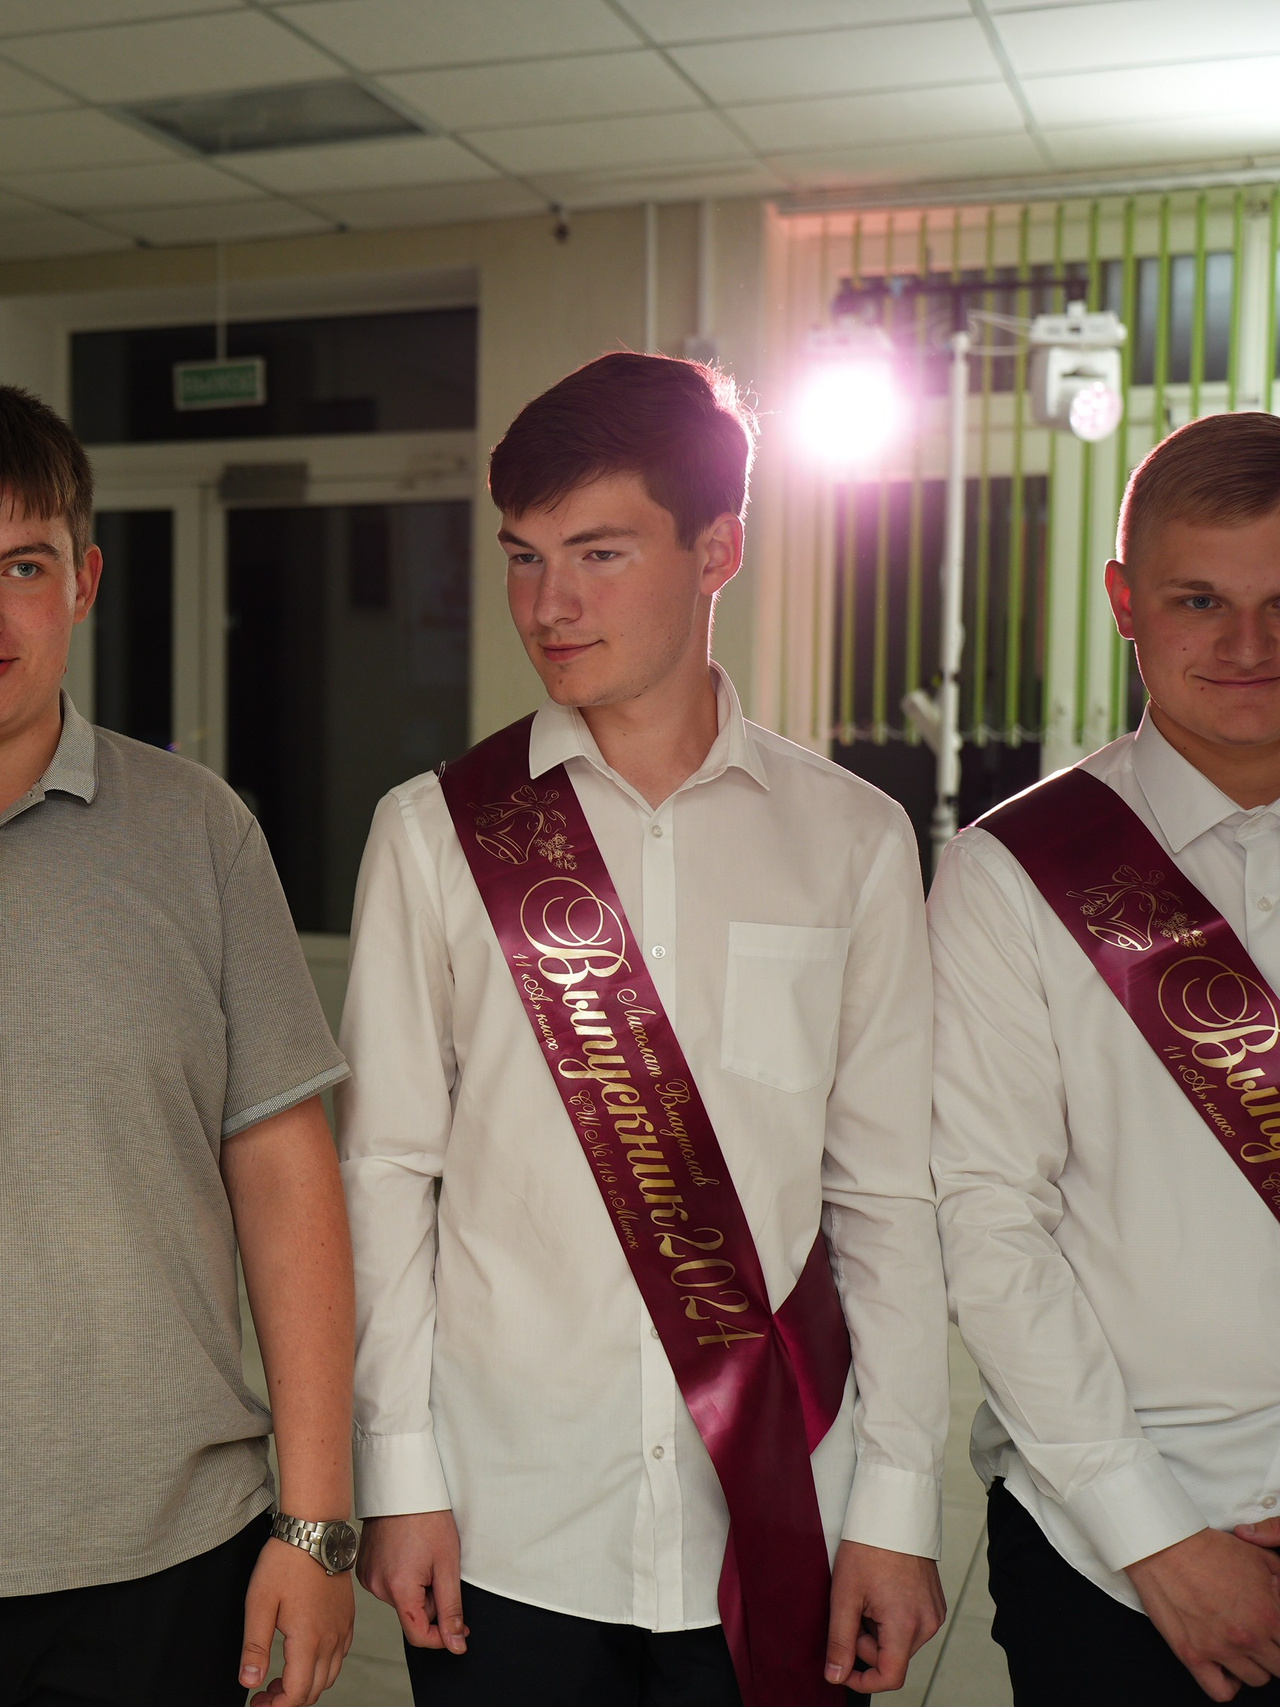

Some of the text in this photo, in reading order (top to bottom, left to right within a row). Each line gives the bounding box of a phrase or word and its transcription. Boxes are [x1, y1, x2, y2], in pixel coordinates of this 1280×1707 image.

[512, 952, 533, 968] 11
[535, 1013, 559, 1051] класс
[518, 875, 765, 1348] Выпускник 2024
[654, 1078, 720, 1188] Владислав
[1162, 1045, 1187, 1060] 11
[1202, 1102, 1237, 1138] класс
[595, 1161, 618, 1183] 119
